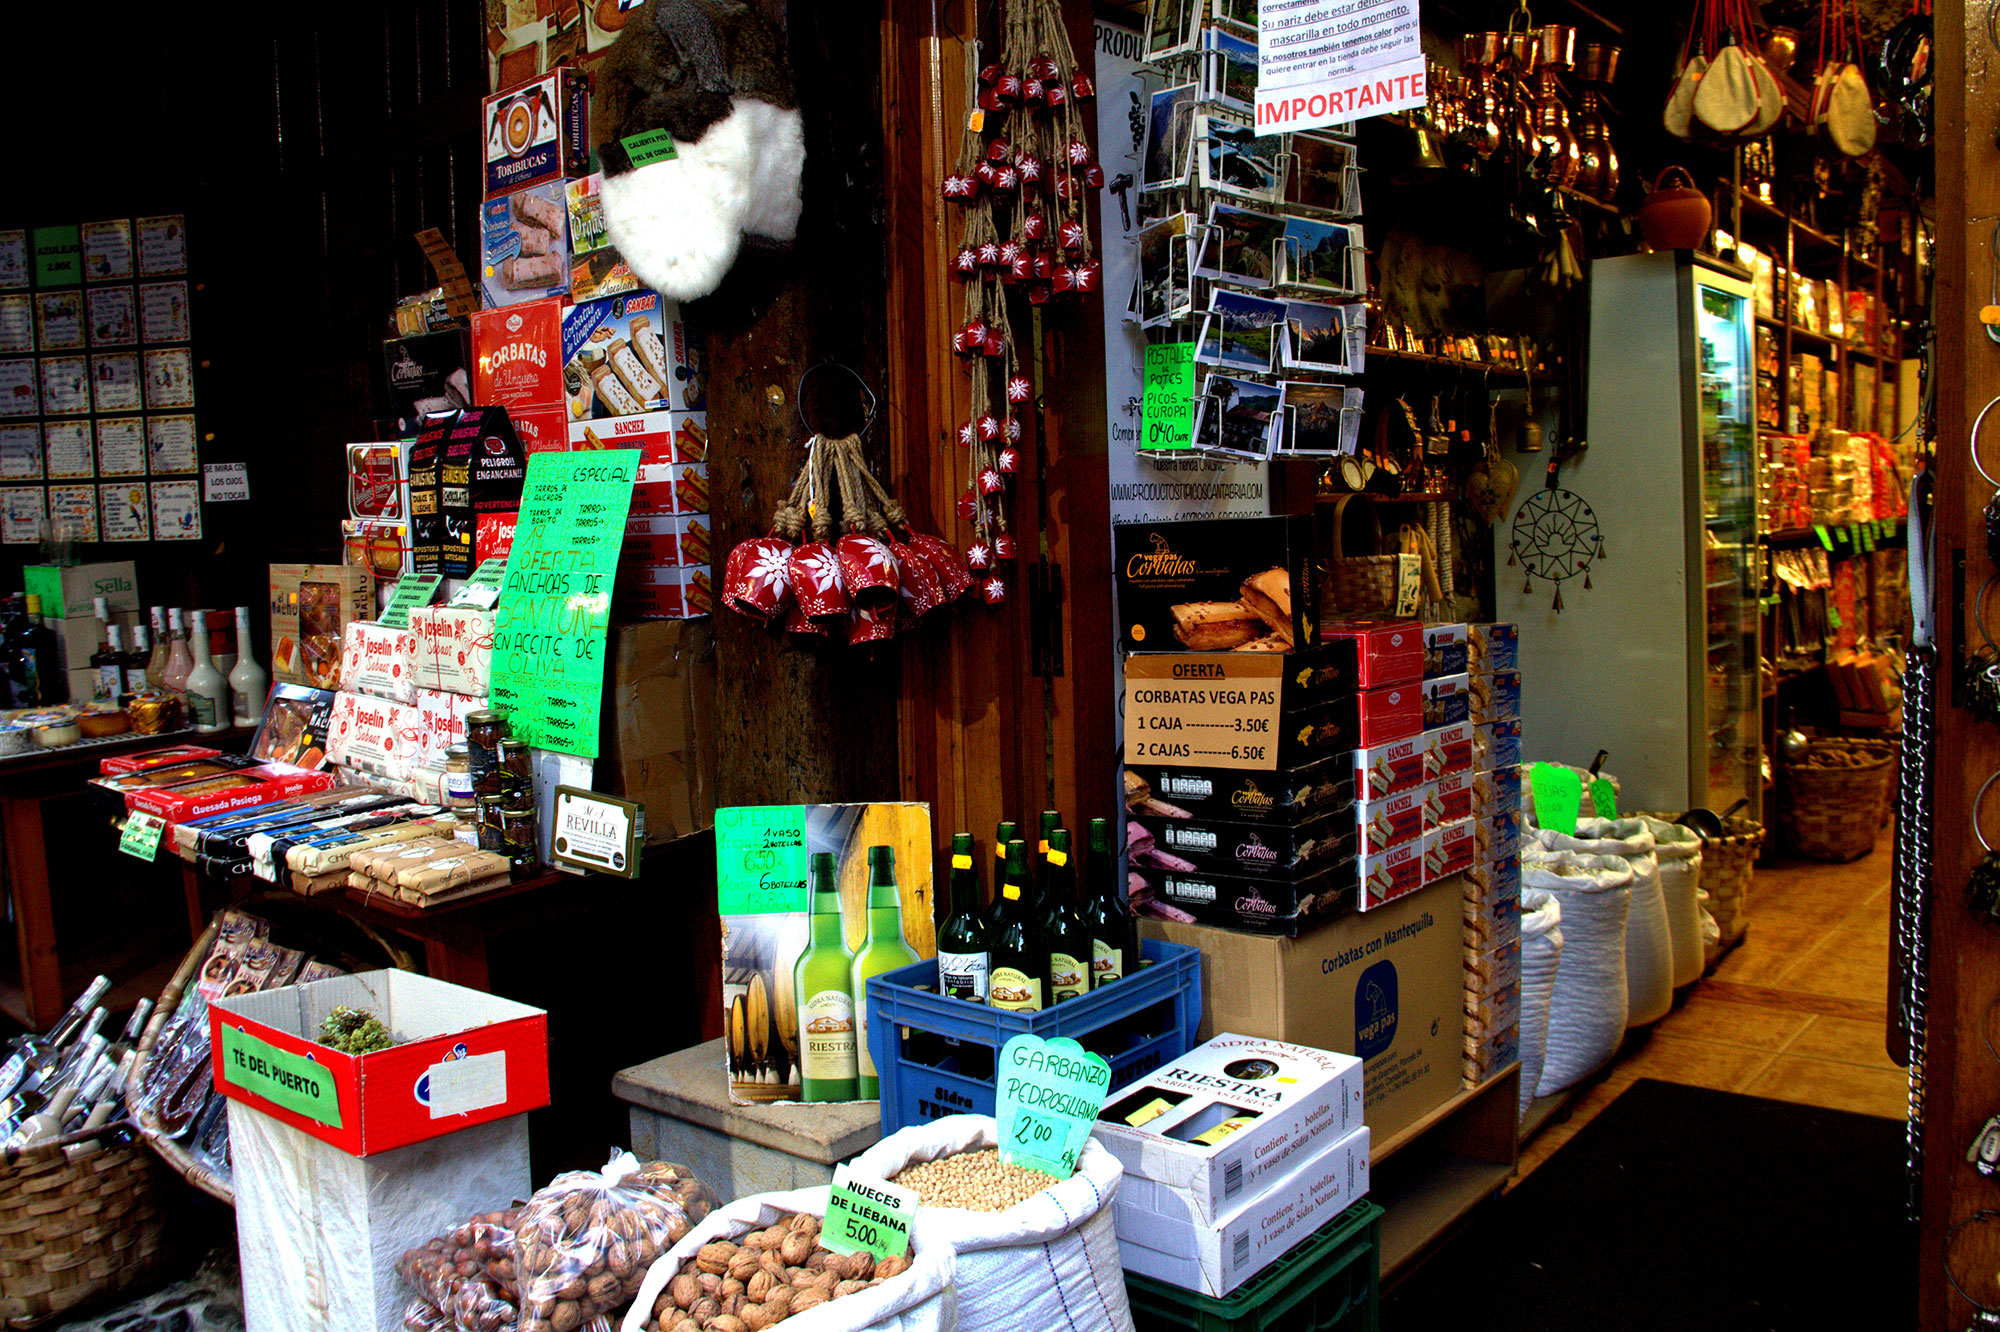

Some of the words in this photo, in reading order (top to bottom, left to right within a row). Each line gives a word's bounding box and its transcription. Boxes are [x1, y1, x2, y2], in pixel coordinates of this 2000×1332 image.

[1262, 19, 1274, 30] Su
[1278, 16, 1301, 27] nariz
[1305, 8, 1328, 23] debe
[1331, 4, 1354, 18] estar
[1270, 27, 1320, 46] mascarilla
[1322, 26, 1334, 35] en
[1337, 18, 1359, 32] todo
[1362, 5, 1410, 25] momento.
[1272, 50, 1307, 60] nosotros
[1309, 42, 1340, 56] también
[1342, 34, 1372, 48] tenemos
[1374, 28, 1392, 40] calor
[1394, 22, 1410, 36] pero
[1266, 65, 1292, 76] quiere
[1293, 60, 1316, 70] entrar
[1318, 58, 1328, 67] en
[1330, 56, 1336, 64] la
[1338, 48, 1359, 62] tienda
[1361, 44, 1379, 56] debe
[1380, 36, 1402, 53] seguir
[1404, 35, 1414, 44] las
[1328, 66, 1356, 78] normas.
[1258, 73, 1424, 126] IMPORTANTE
[628, 136, 656, 150] CALIENTA
[656, 134, 668, 144] PIES
[631, 153, 647, 163] PIEL
[654, 146, 674, 157] CONEJO
[626, 296, 656, 314] SANBAR
[486, 342, 547, 374] CORBATAS
[1147, 346, 1194, 366] POSTALES
[1150, 372, 1182, 385] POTES
[1147, 406, 1186, 418] EUROPA
[614, 420, 645, 435] SANCHEZ
[214, 464, 233, 472] MIRA
[476, 469, 522, 480] ENGANCHAN!!
[211, 478, 224, 486] LOS
[1111, 484, 1263, 500] WWW.PRODUCTOSTIPICOSCANTABRIA.COM
[223, 492, 246, 500] TOCAR
[474, 500, 520, 510] ADVERTENCIA
[520, 550, 595, 572] OFERTA
[1126, 553, 1196, 579] Corbatas
[1144, 554, 1163, 564] vega
[1164, 552, 1178, 562] pas
[94, 578, 132, 594] Sella
[508, 572, 570, 594] ANCHOAS
[584, 574, 602, 594] DE
[424, 618, 452, 640] joselin
[365, 637, 392, 657] joselin
[494, 632, 512, 650] EN
[514, 633, 562, 656] ACEITE
[576, 638, 595, 660] DE
[508, 653, 565, 678] OLIVA
[1172, 664, 1226, 678] OFERTA
[1134, 690, 1206, 704] CORBATAS
[1210, 690, 1247, 704] VEGA
[1250, 691, 1275, 705] PAS
[355, 706, 384, 728] joselin
[434, 712, 463, 735] joselin
[1138, 716, 1146, 730] 1
[1150, 716, 1183, 730] CAJA
[1441, 727, 1463, 744] SANCHEZ
[1137, 742, 1145, 756] 2
[1150, 742, 1190, 757] CAJAS
[1388, 742, 1413, 761] SANCHEZ
[284, 784, 304, 794] Joselin
[1438, 776, 1462, 794] SANCHEZ
[192, 800, 230, 816] Quesada
[230, 793, 262, 809] Pasiega
[1386, 795, 1412, 815] SANCHEZ
[567, 814, 616, 840] REVILLA
[724, 808, 796, 828] OFERTA
[772, 829, 801, 838] VASO
[1442, 826, 1465, 844] SANCHEZ
[1386, 846, 1412, 867] SANCHEZ
[1322, 948, 1364, 975] Corbatas
[1366, 938, 1382, 956] con
[1384, 912, 1434, 946] Mantequilla
[1358, 1020, 1380, 1042] vega
[1381, 1012, 1396, 1030] pas
[809, 1040, 856, 1052] RIESTRA
[1209, 1038, 1267, 1050] SIDRA
[1272, 1040, 1335, 1072] NATURAL
[233, 1047, 246, 1064] TÉ
[249, 1055, 270, 1079] DEL
[272, 1068, 320, 1099] PUERTO
[1014, 1046, 1107, 1086] GARBANZO
[1163, 1067, 1284, 1102] RIESTRA
[935, 1086, 973, 1109] Sidra
[1213, 1090, 1275, 1109] ASTURIAS
[1254, 1131, 1289, 1160] Contiene
[1294, 1123, 1300, 1135] 2
[1304, 1102, 1331, 1128] botellas
[1250, 1169, 1257, 1184] y
[1263, 1156, 1281, 1175] vaso
[1281, 1148, 1291, 1166] de
[1291, 1134, 1308, 1158] Sidra
[1309, 1113, 1334, 1142] Natural
[846, 1180, 901, 1210] NUECES
[1261, 1201, 1294, 1231] Contiene
[1299, 1192, 1304, 1204] 2
[1309, 1172, 1336, 1198] botellas
[831, 1194, 848, 1210] DE
[851, 1202, 907, 1234] LIÉBANA
[1257, 1240, 1264, 1253] y
[1269, 1225, 1286, 1245] vaso
[1286, 1218, 1296, 1234] de
[1296, 1202, 1314, 1227] Sidra
[1314, 1184, 1340, 1211] Natural
[846, 1217, 877, 1246] 5.00
